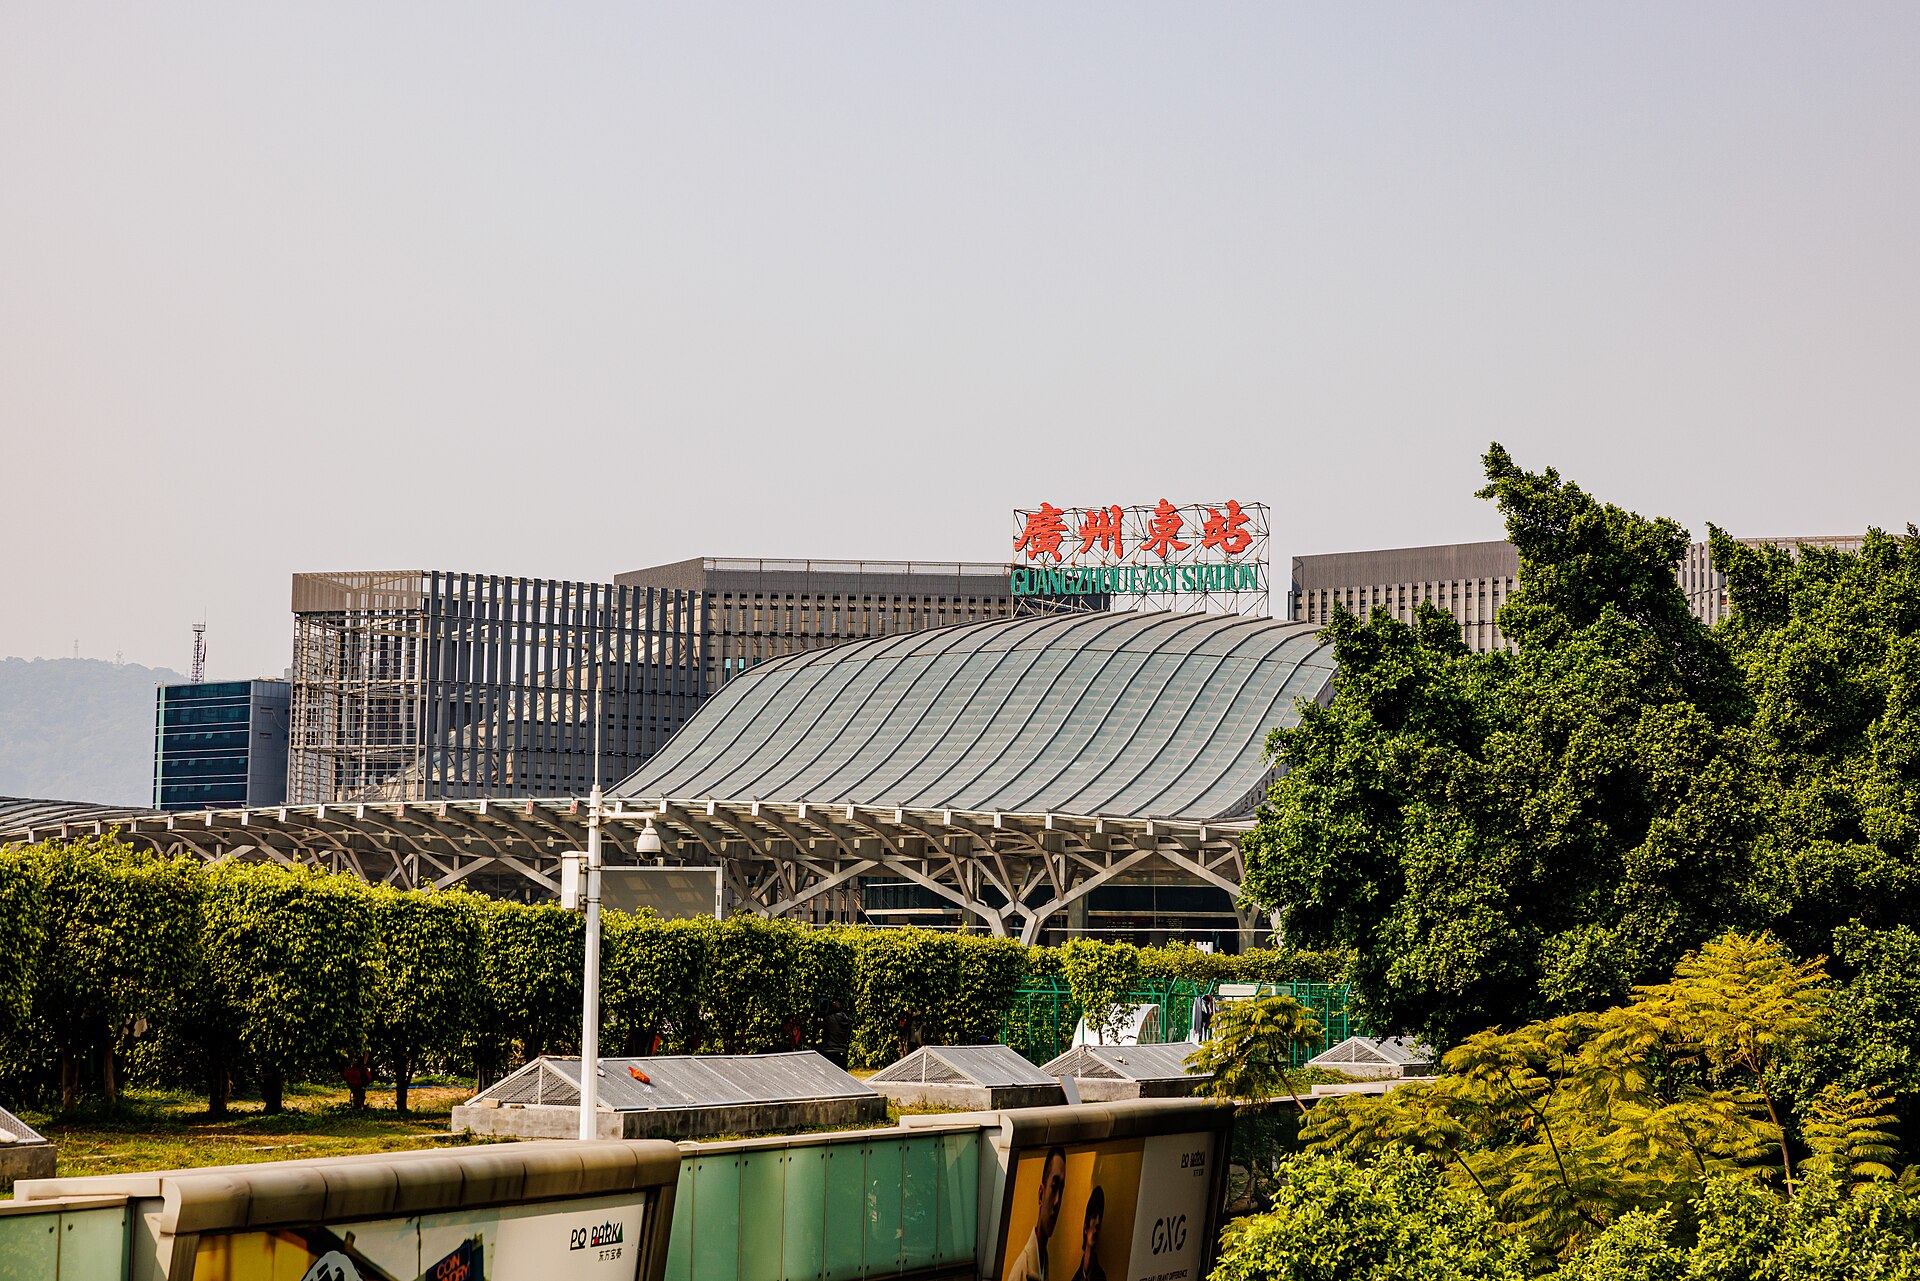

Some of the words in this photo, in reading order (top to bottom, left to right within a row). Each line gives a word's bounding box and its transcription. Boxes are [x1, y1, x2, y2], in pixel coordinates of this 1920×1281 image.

[1011, 566, 1127, 595] GUANGZHOU
[1130, 565, 1180, 593] EAST
[1181, 564, 1258, 592] STATION
[590, 1220, 623, 1247] PARK
[1151, 1214, 1187, 1255] GXG
[437, 1252, 460, 1279] COIN
